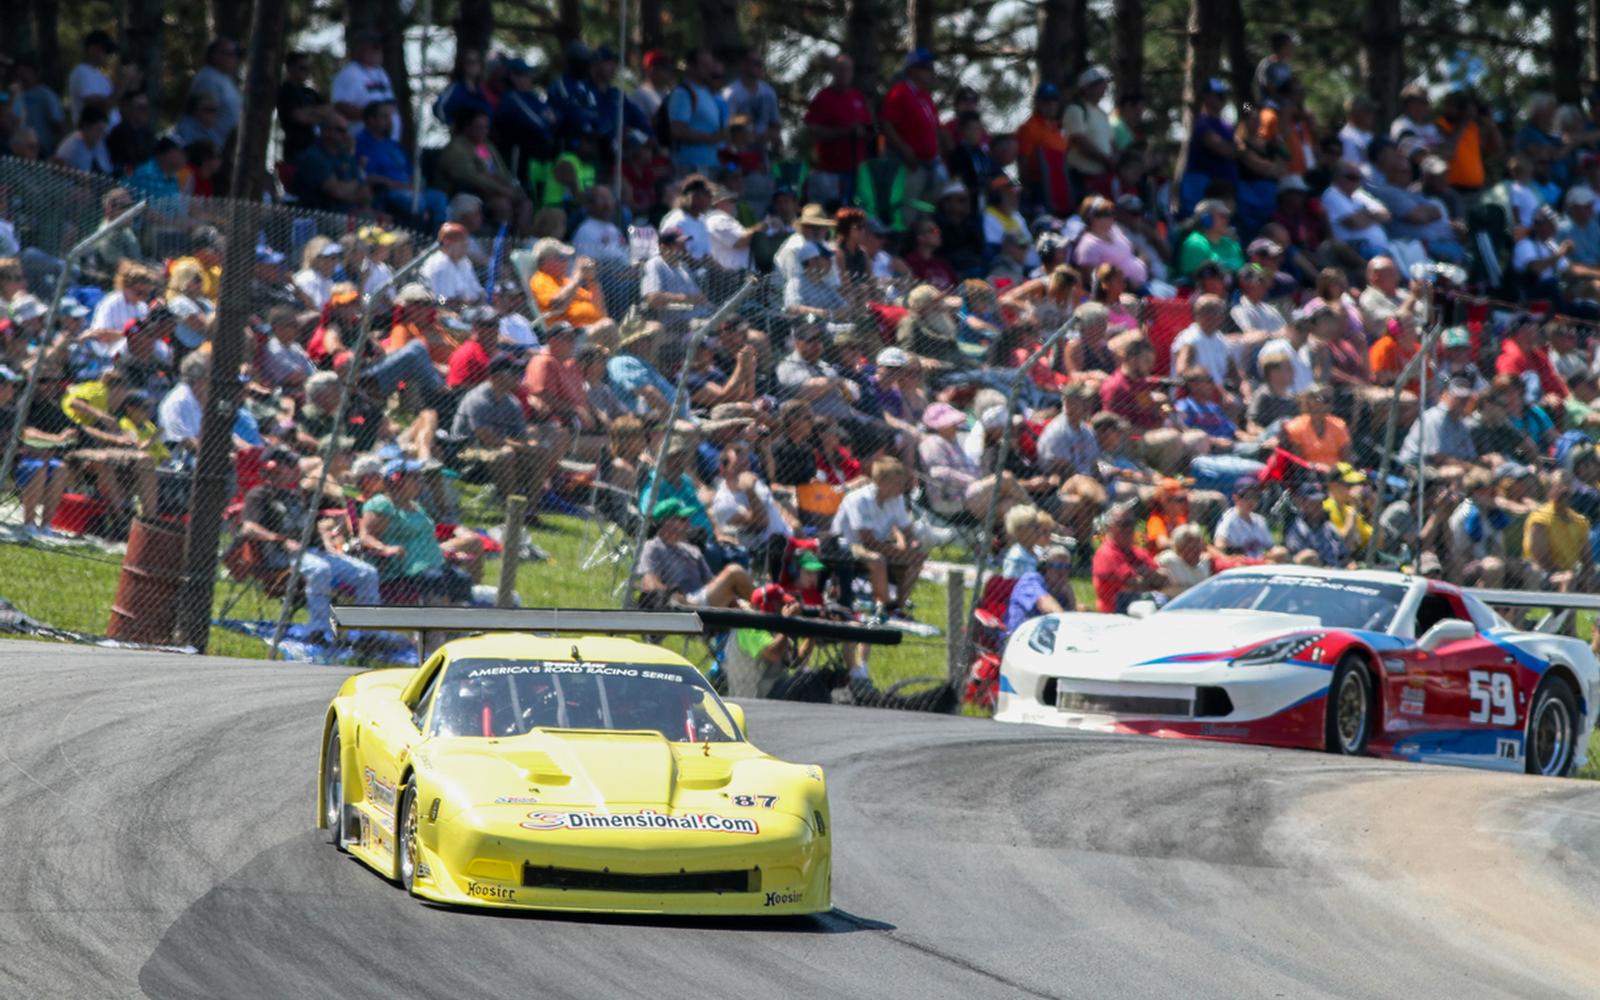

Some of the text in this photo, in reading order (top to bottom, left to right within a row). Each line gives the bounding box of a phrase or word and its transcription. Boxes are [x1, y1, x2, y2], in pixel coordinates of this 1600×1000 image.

[468, 666, 683, 683] AMERICA'S ROAD RACING SERIES
[1468, 669, 1517, 727] 59
[1499, 741, 1515, 759] TA
[733, 794, 777, 808] 87
